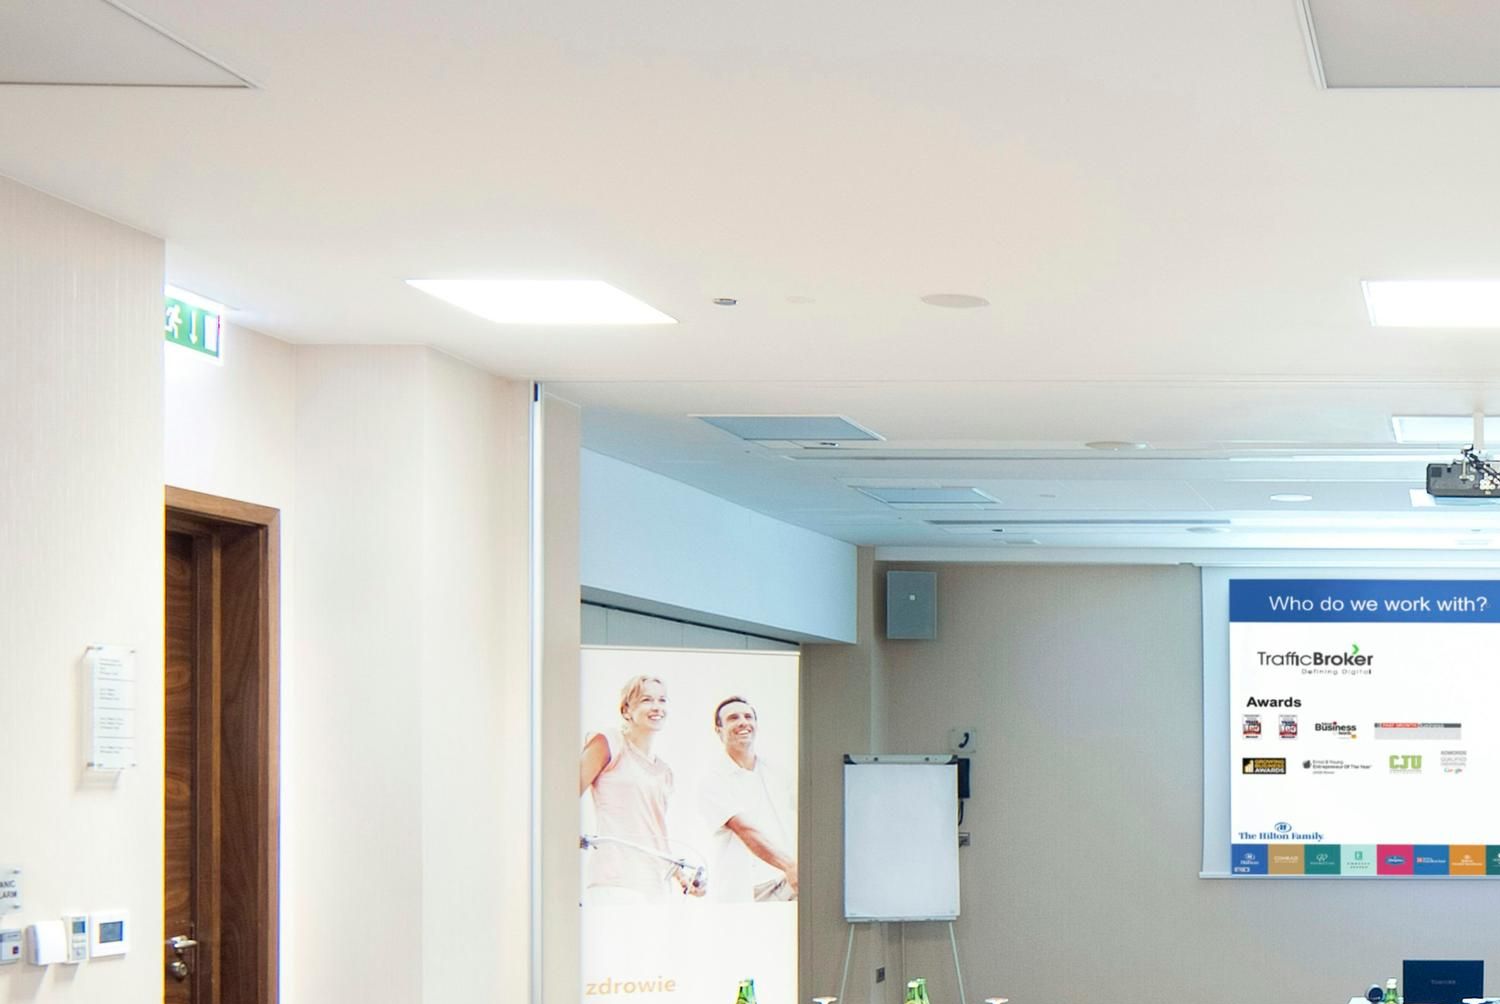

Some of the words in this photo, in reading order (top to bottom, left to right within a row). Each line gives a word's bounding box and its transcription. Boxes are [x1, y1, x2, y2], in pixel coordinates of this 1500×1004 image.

[1269, 596, 1314, 611] Who
[1320, 596, 1344, 611] do
[1350, 600, 1378, 611] we
[1384, 597, 1431, 611] work
[1436, 597, 1488, 612] with?
[1257, 651, 1374, 667] TrafficBroker
[1246, 696, 1302, 708] Awards
[1314, 721, 1357, 732] Business
[1238, 832, 1257, 840] The
[1259, 832, 1289, 840] Hilton
[1291, 832, 1323, 842] Family
[585, 976, 677, 996] zdrowie
